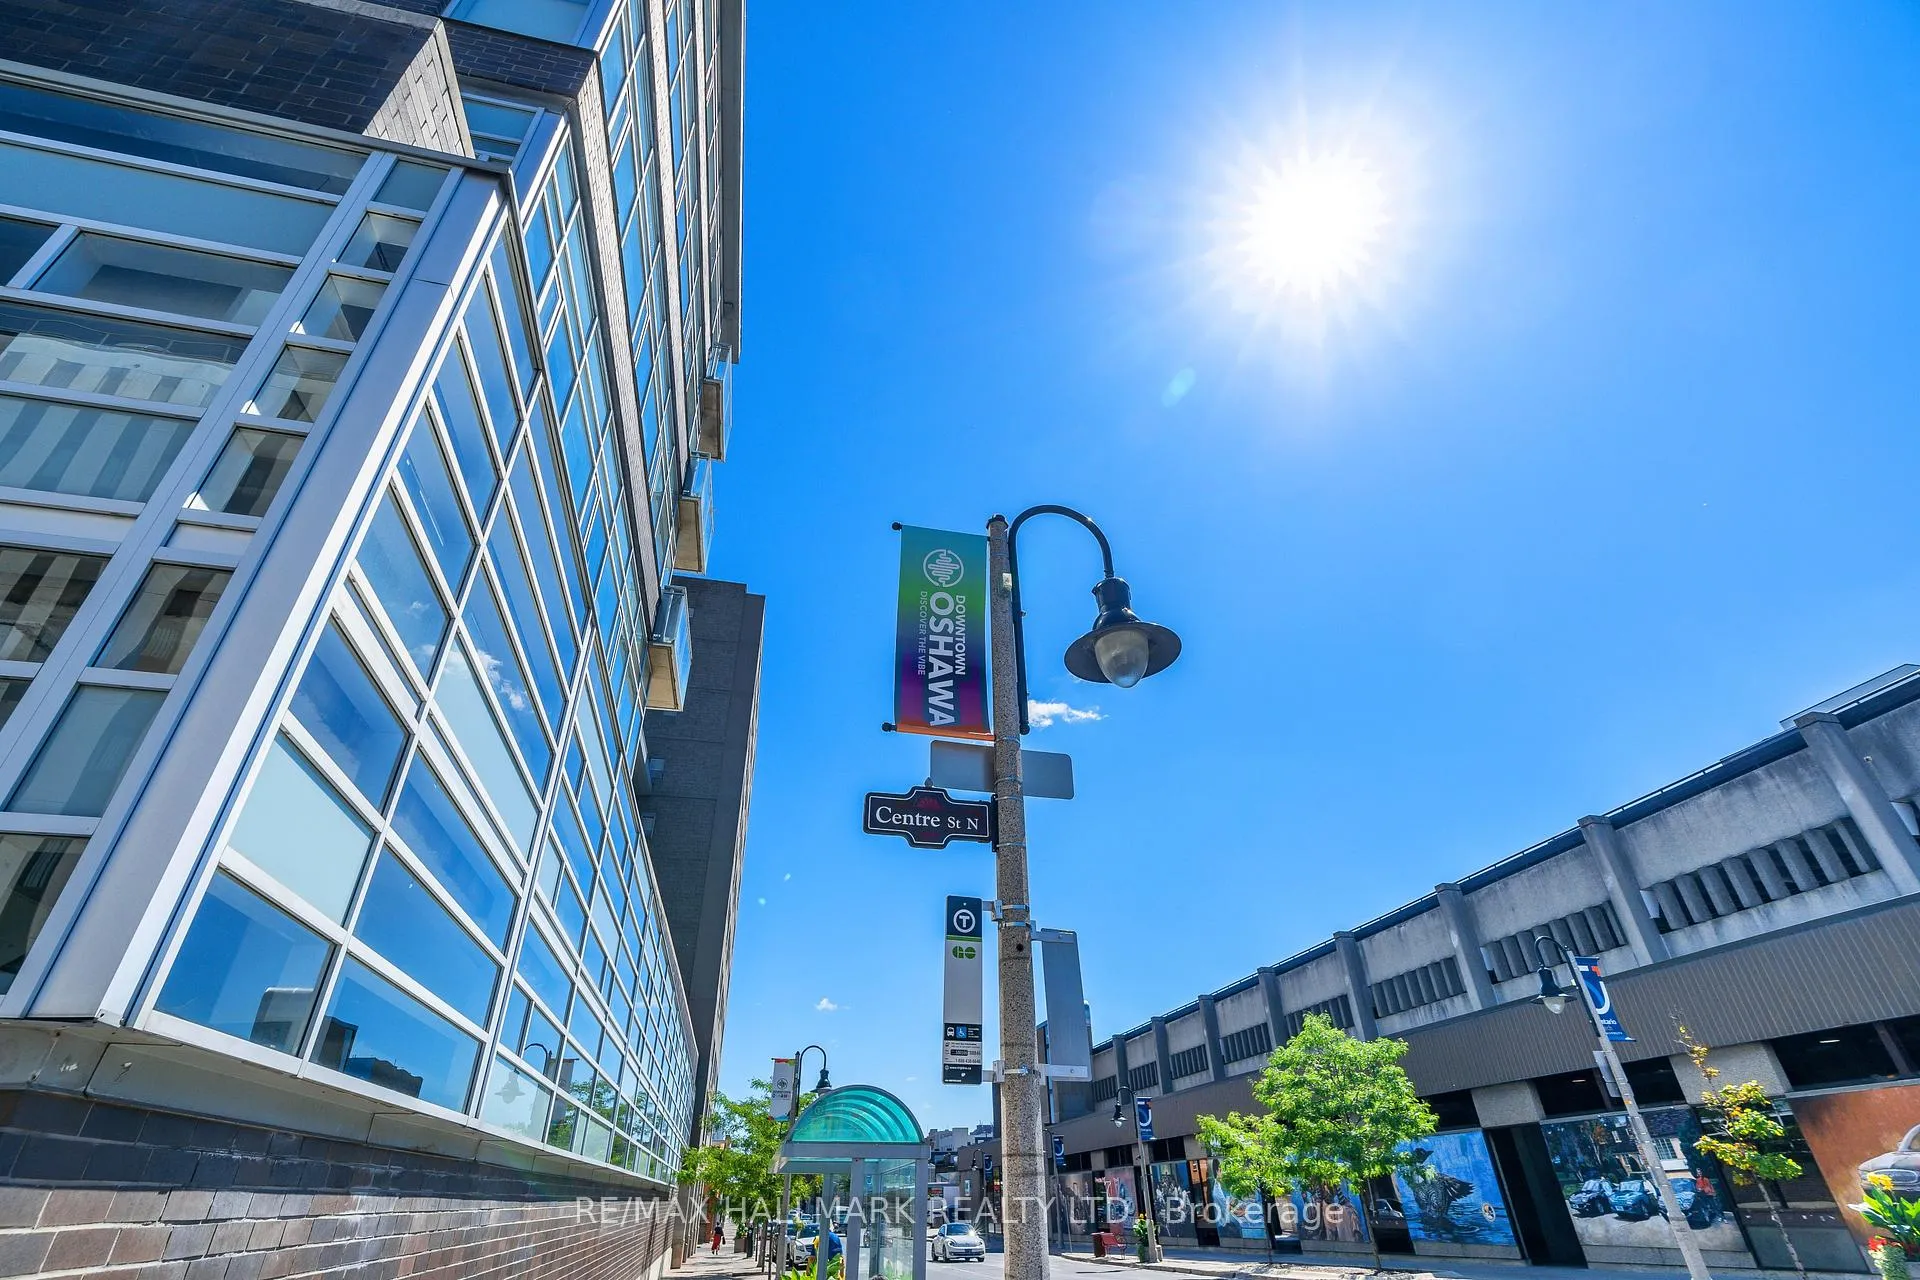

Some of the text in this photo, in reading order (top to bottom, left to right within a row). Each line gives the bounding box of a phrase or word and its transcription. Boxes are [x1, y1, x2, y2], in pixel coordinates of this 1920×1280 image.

[917, 591, 928, 676] DISCOVER THE VIBE
[928, 591, 955, 727] OSHAWA
[955, 595, 966, 675] DOWNTOWN
[875, 806, 979, 830] Centre St N
[958, 915, 970, 928] T
